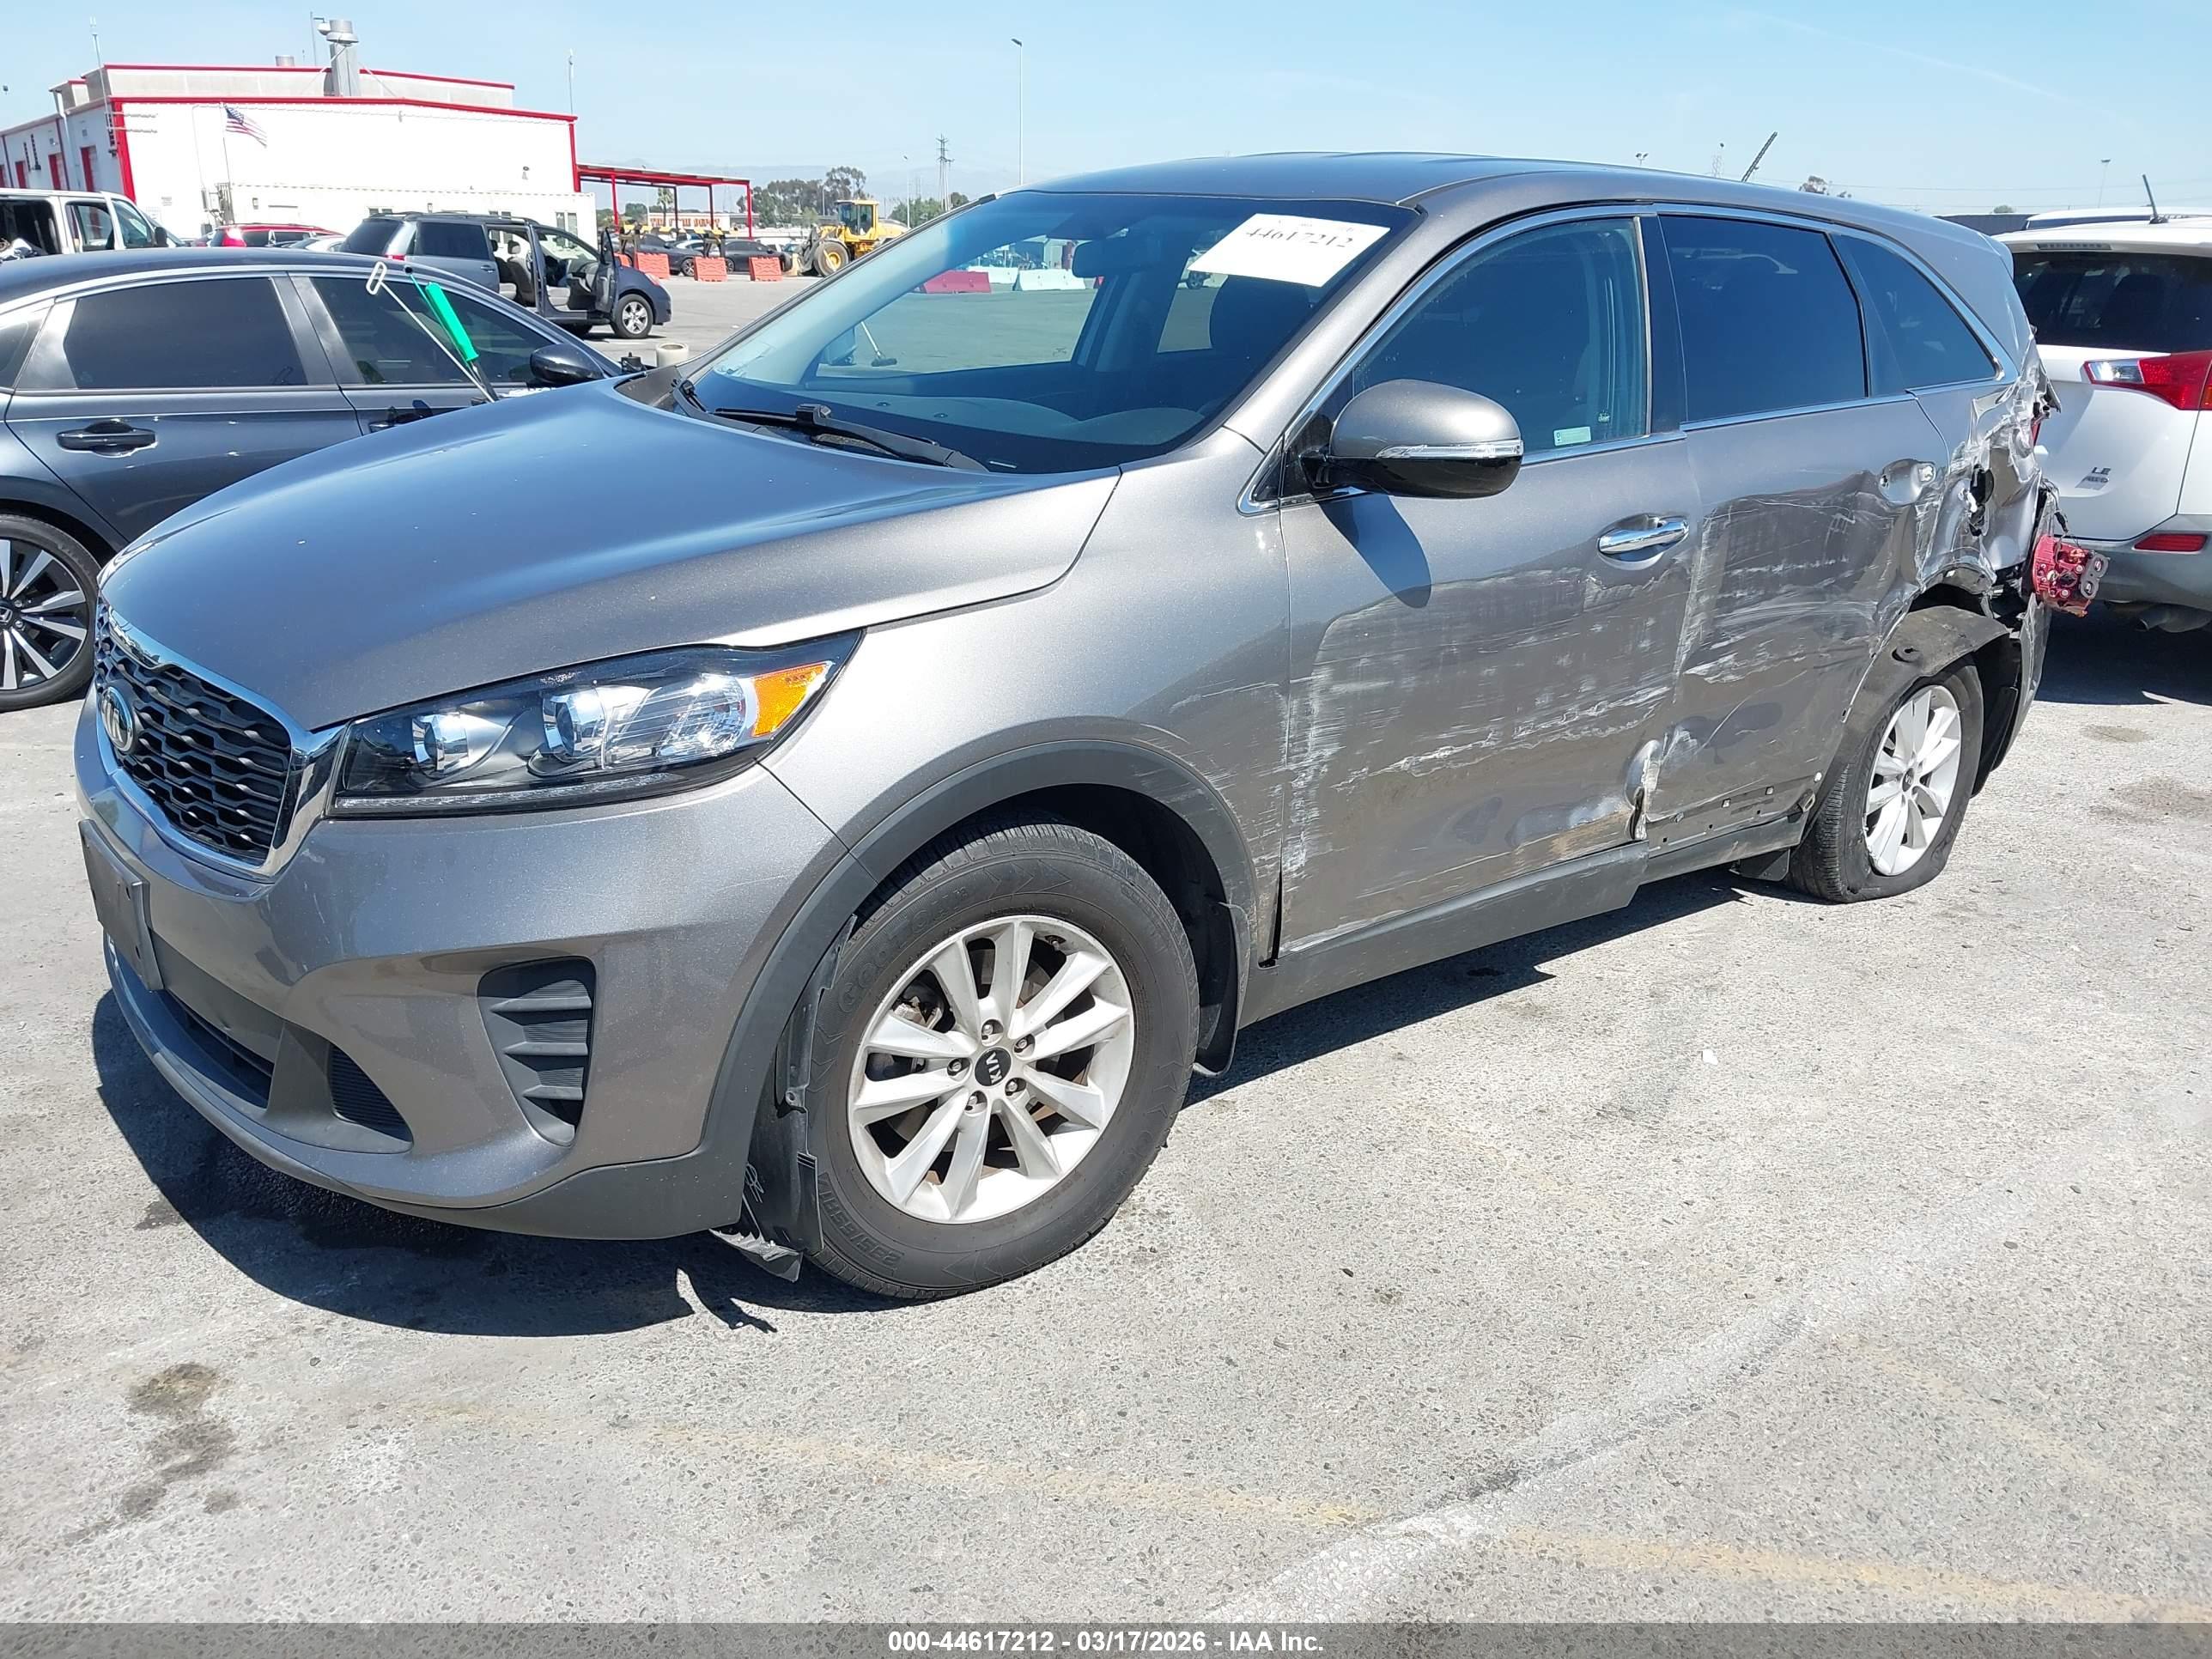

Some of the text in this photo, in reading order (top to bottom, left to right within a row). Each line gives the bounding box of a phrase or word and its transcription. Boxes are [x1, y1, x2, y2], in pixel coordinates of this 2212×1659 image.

[1245, 227, 1354, 248] 44617212
[2091, 466, 2112, 475] LE
[986, 1051, 1003, 1085] KIA
